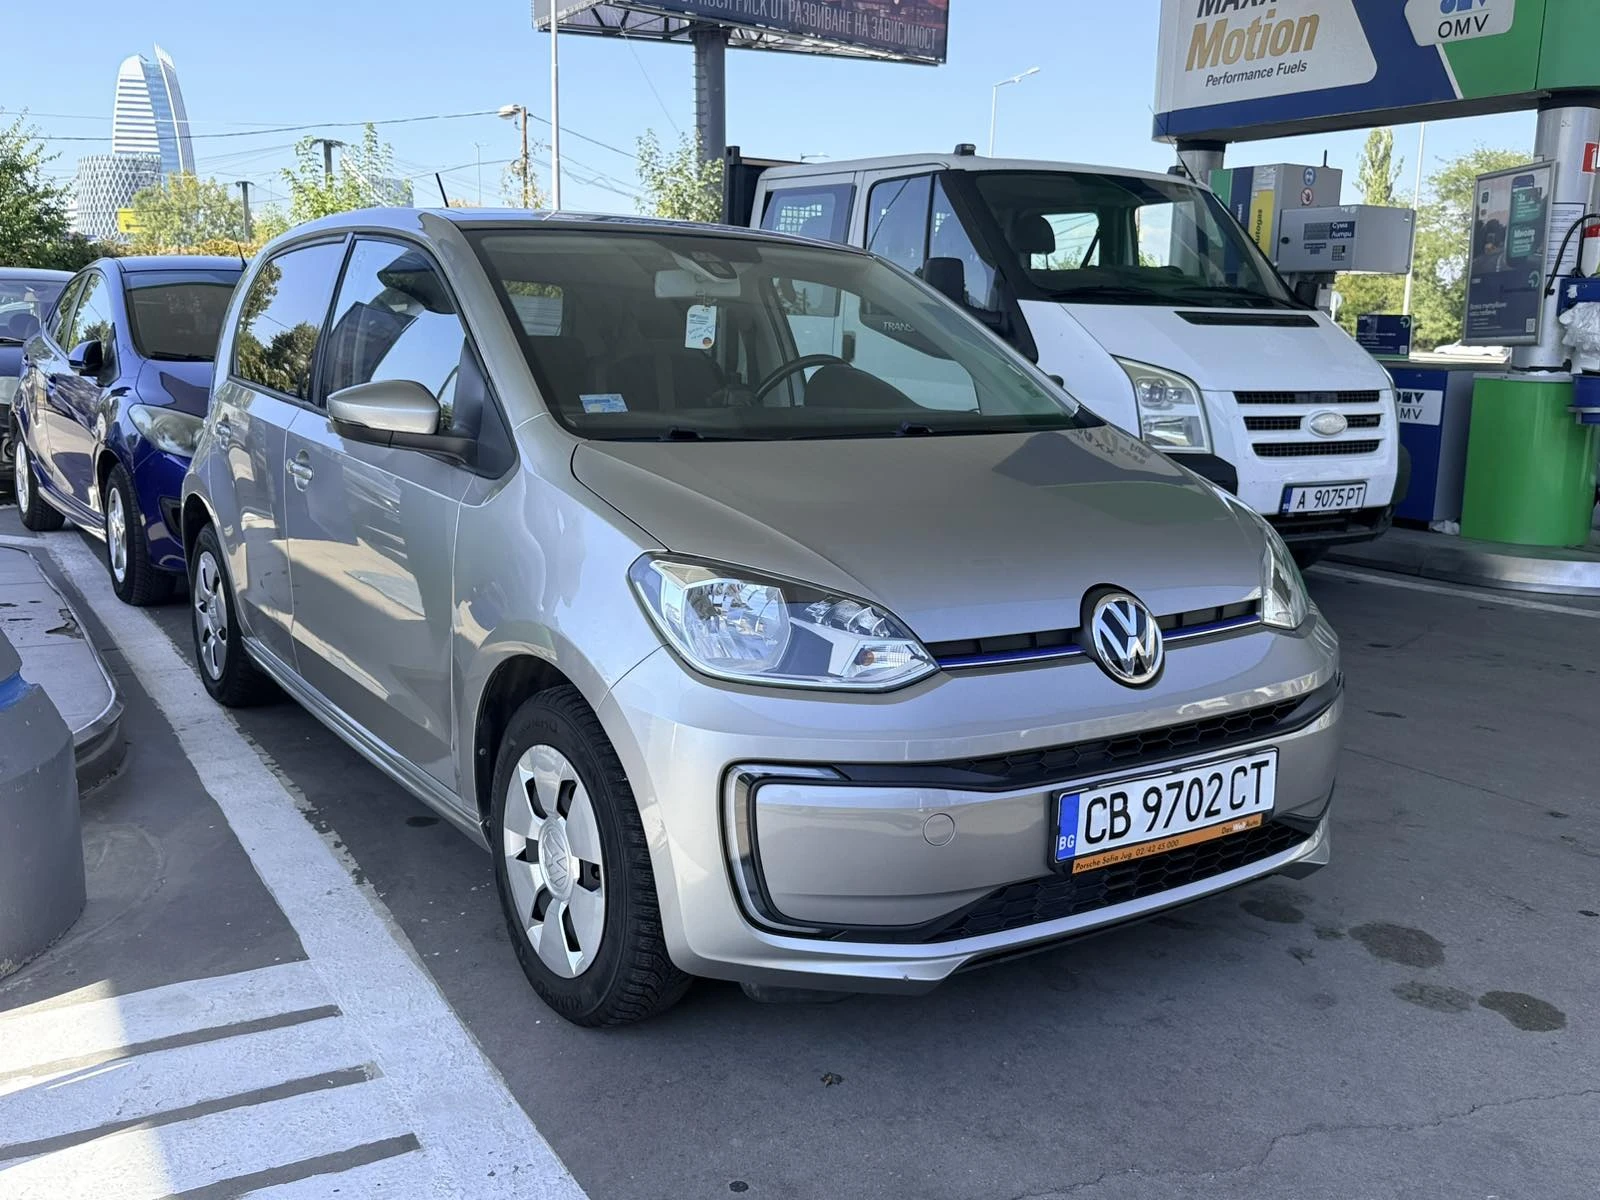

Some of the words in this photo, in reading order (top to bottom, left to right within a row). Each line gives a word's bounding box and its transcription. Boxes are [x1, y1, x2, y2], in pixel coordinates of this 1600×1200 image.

[788, 0, 852, 34] РАЗВИВАНЕ
[854, 11, 869, 37] НА
[871, 17, 936, 49] ЗАВИСИМОСТ
[1438, 14, 1489, 38] OMV
[1185, 8, 1320, 72] Motion
[1205, 66, 1274, 87] Performance
[1276, 60, 1308, 75] Fuels
[1399, 408, 1423, 420] MV
[1084, 791, 1132, 845] CB
[1058, 834, 1075, 851] BG
[1075, 860, 1101, 871] Porsche
[1102, 854, 1119, 865] Sofia
